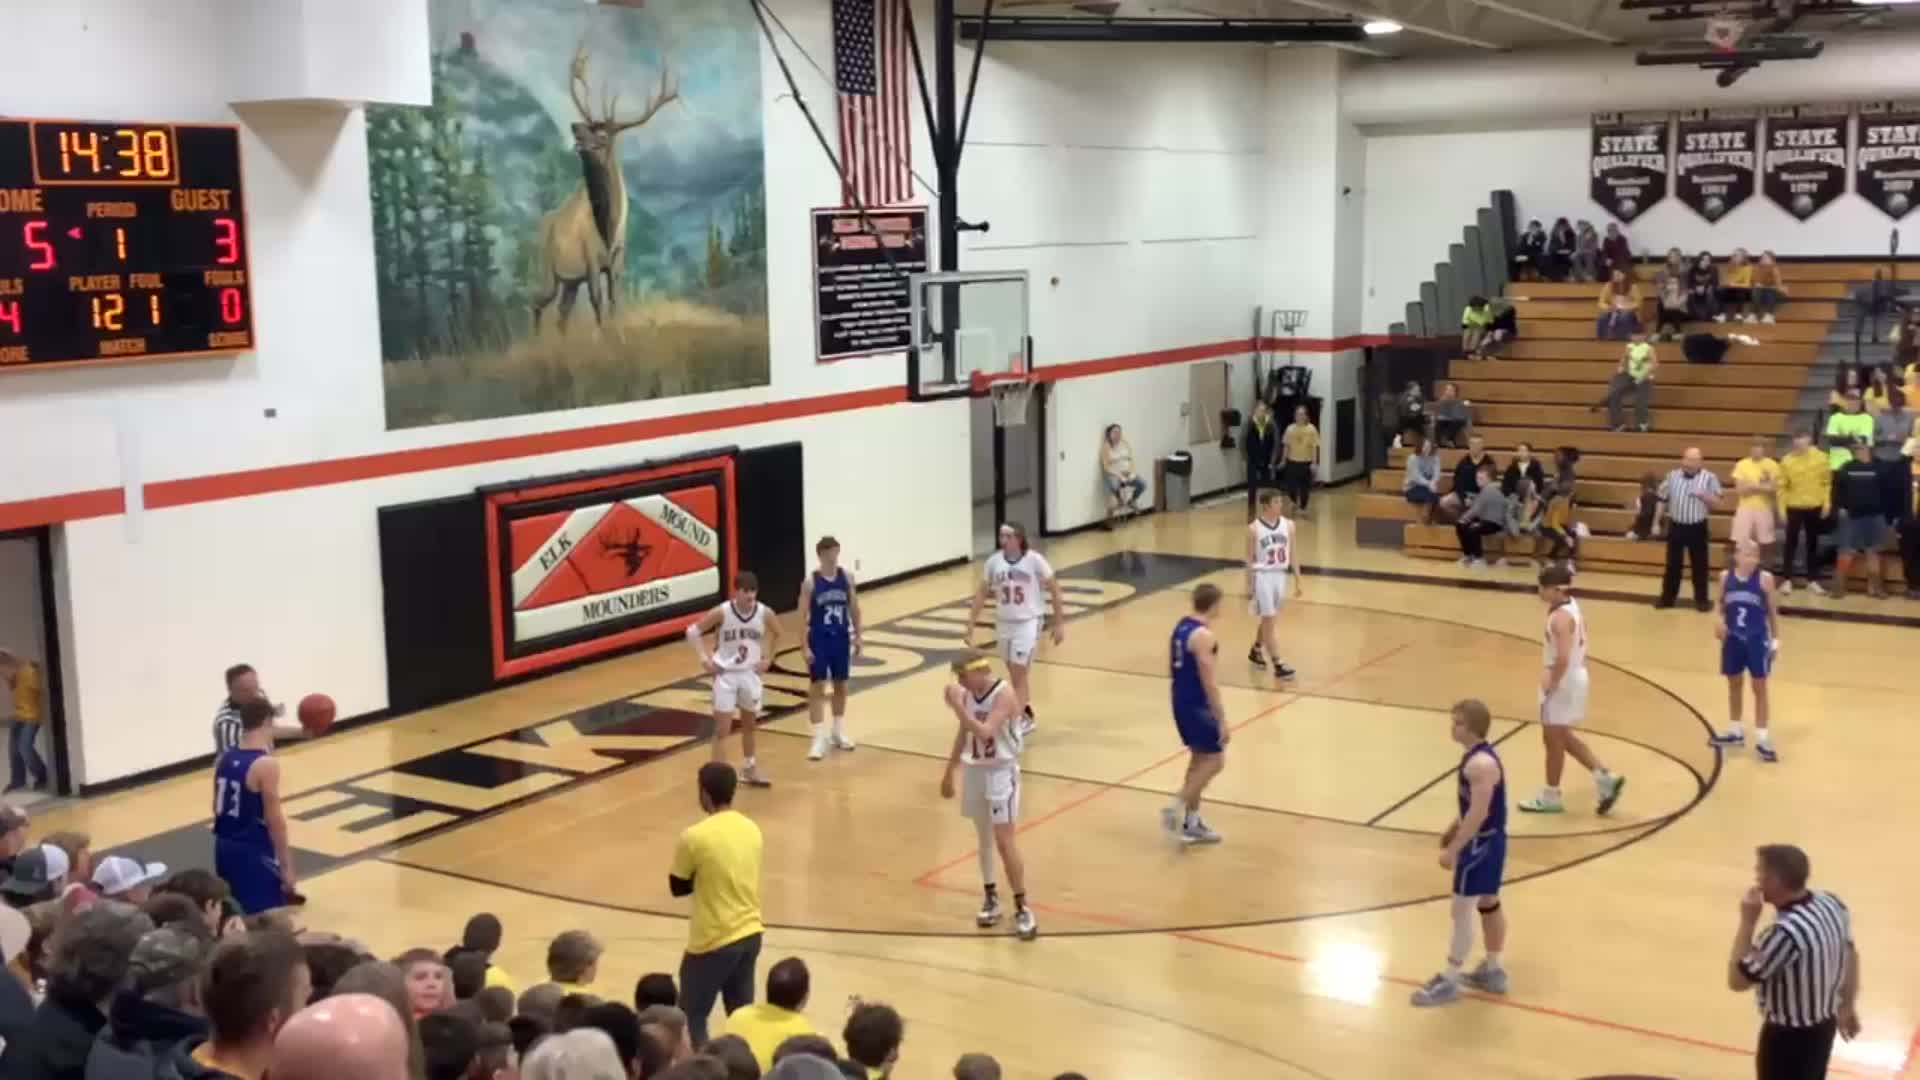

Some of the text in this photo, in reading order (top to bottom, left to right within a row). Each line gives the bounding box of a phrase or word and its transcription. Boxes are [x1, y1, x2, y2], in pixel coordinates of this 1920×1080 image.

[1600, 134, 1659, 153] STATE
[1684, 131, 1747, 150] STATE
[1774, 128, 1838, 148] STATE
[1866, 125, 1920, 145] STAT
[59, 129, 171, 177] 14:38
[170, 189, 231, 211] GUEST
[24, 221, 56, 269] 5
[115, 227, 127, 260] 1
[213, 218, 239, 264] 3
[68, 275, 121, 292] PLAYER
[91, 293, 124, 331] 12
[150, 294, 161, 326] 1
[220, 287, 242, 323] 0
[537, 503, 712, 572] ELK MOUND
[581, 584, 671, 622] MOUNDERS
[1001, 585, 1024, 605] 35
[823, 605, 843, 625] 24
[1737, 606, 1747, 627] 2
[735, 645, 748, 665] 3
[215, 776, 241, 818] 13
